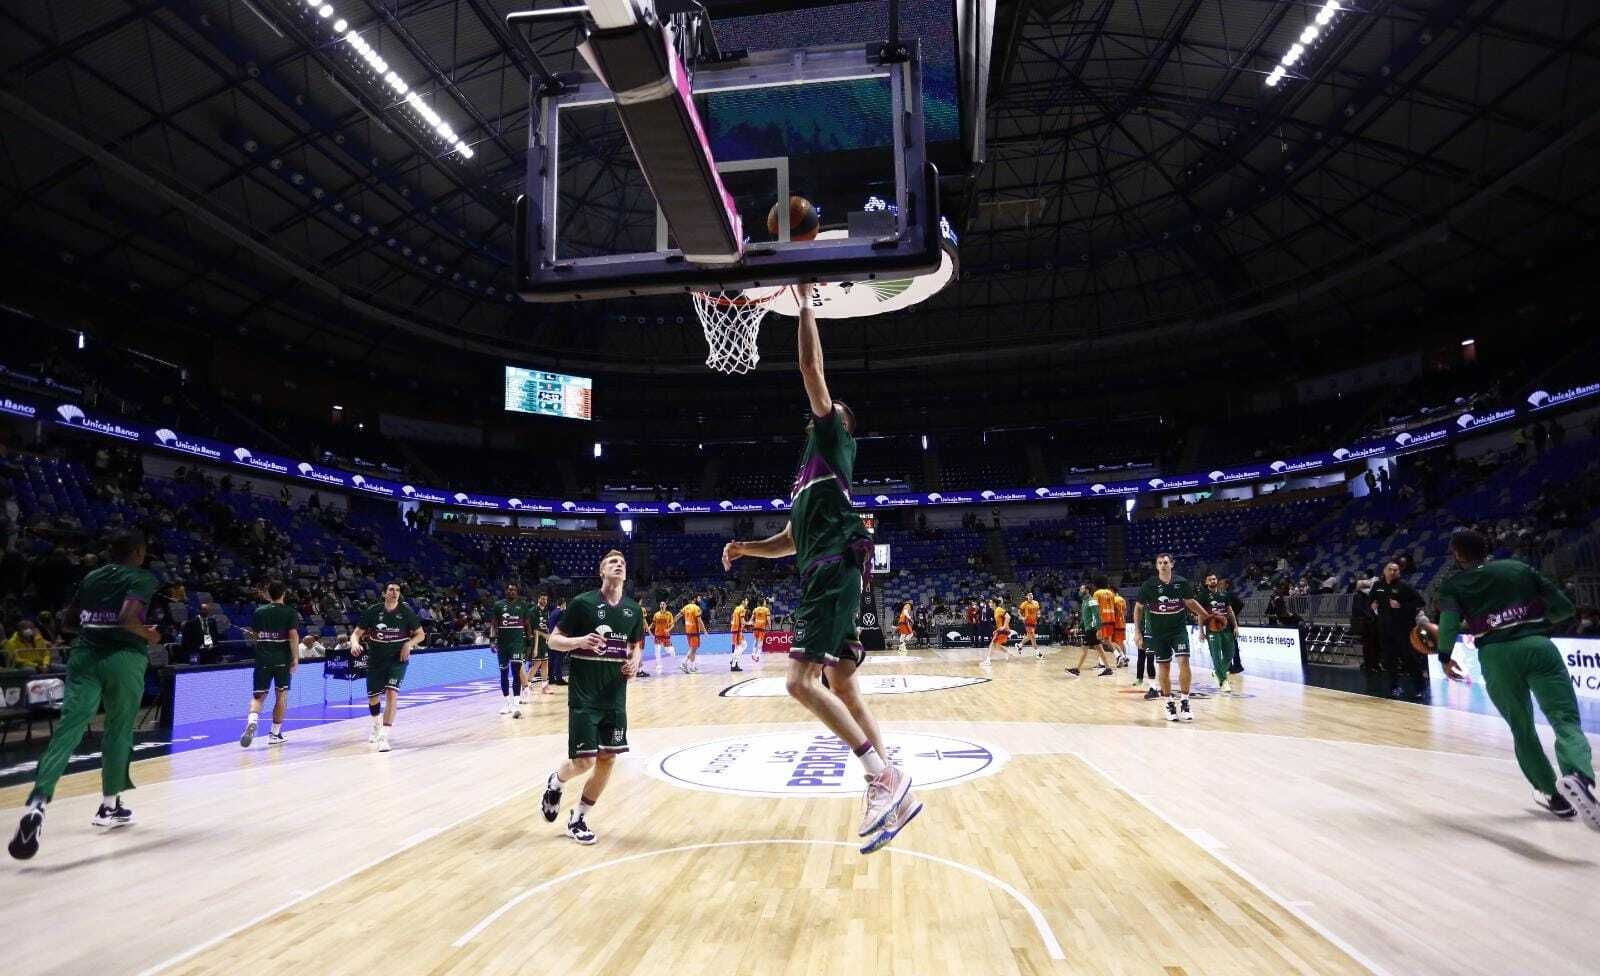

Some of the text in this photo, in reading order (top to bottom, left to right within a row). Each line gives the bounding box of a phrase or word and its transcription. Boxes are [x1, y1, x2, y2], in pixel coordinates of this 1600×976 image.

[1547, 383, 1600, 404] Unicaja Banco
[4, 399, 36, 414] Banco
[1472, 409, 1515, 426] Unicaja Banco
[82, 419, 139, 438] Unicaja Banco
[1410, 429, 1447, 444] Unicaja Banco
[175, 440, 221, 457] Unicaja Banco
[1368, 445, 1386, 456] Banco
[271, 462, 288, 472] Banco
[1266, 634, 1274, 645] de
[1275, 636, 1295, 648] riesgo
[786, 735, 852, 787] PEDRIZAS
